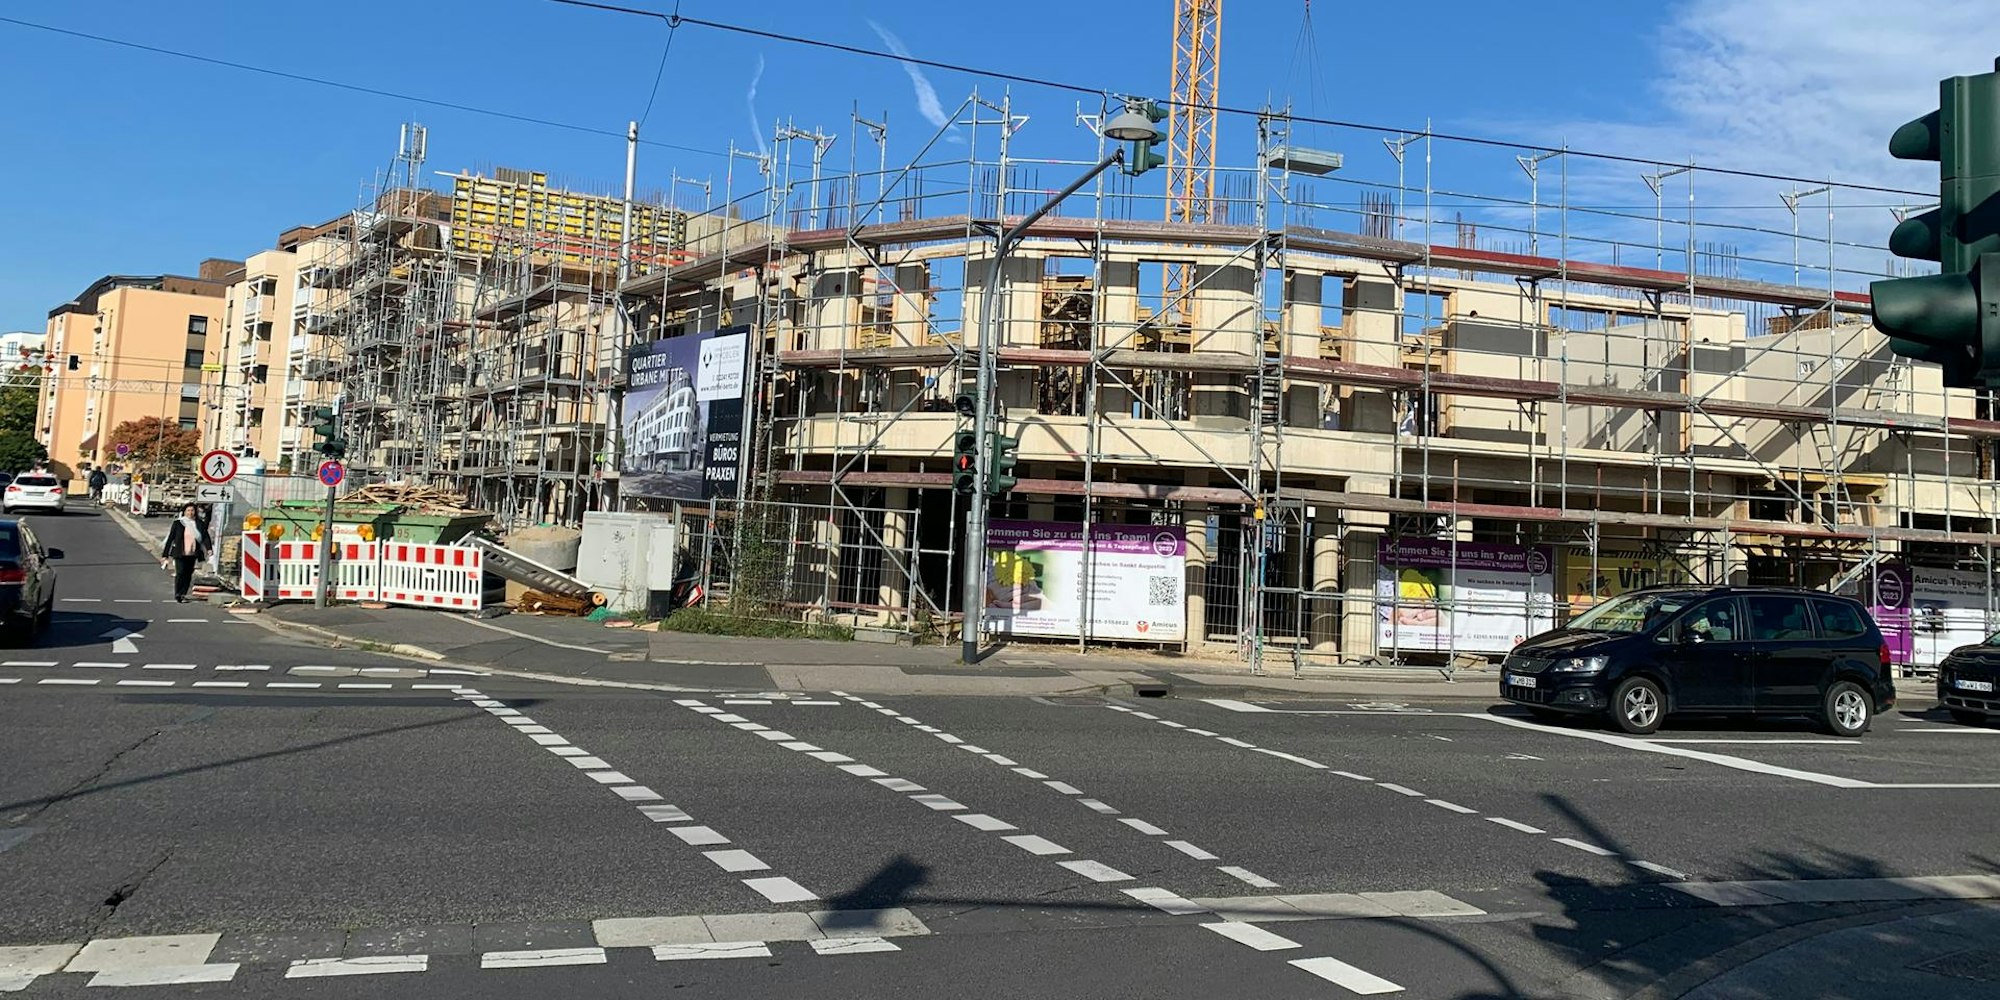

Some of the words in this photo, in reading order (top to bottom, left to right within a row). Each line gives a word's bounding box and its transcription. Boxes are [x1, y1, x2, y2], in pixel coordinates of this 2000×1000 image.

[631, 353, 667, 373] QUARTIER
[631, 370, 659, 387] URBANE
[659, 367, 683, 383] MITTE
[709, 432, 739, 442] VERMIETUNG
[712, 444, 738, 462] BÜROS
[705, 466, 737, 481] PRAXEN
[988, 528, 1030, 538] ommen
[1032, 528, 1052, 539] Sie
[1053, 530, 1067, 539] zu
[1094, 531, 1112, 541] ins
[1114, 532, 1151, 543] Team!
[1430, 547, 1446, 556] Sie
[1460, 550, 1479, 559] uns
[1480, 549, 1495, 560] ins
[1497, 551, 1526, 562] Team!
[1914, 574, 1948, 585] Amicus
[1882, 591, 1899, 600] 2023
[1151, 620, 1178, 629] Amicus
